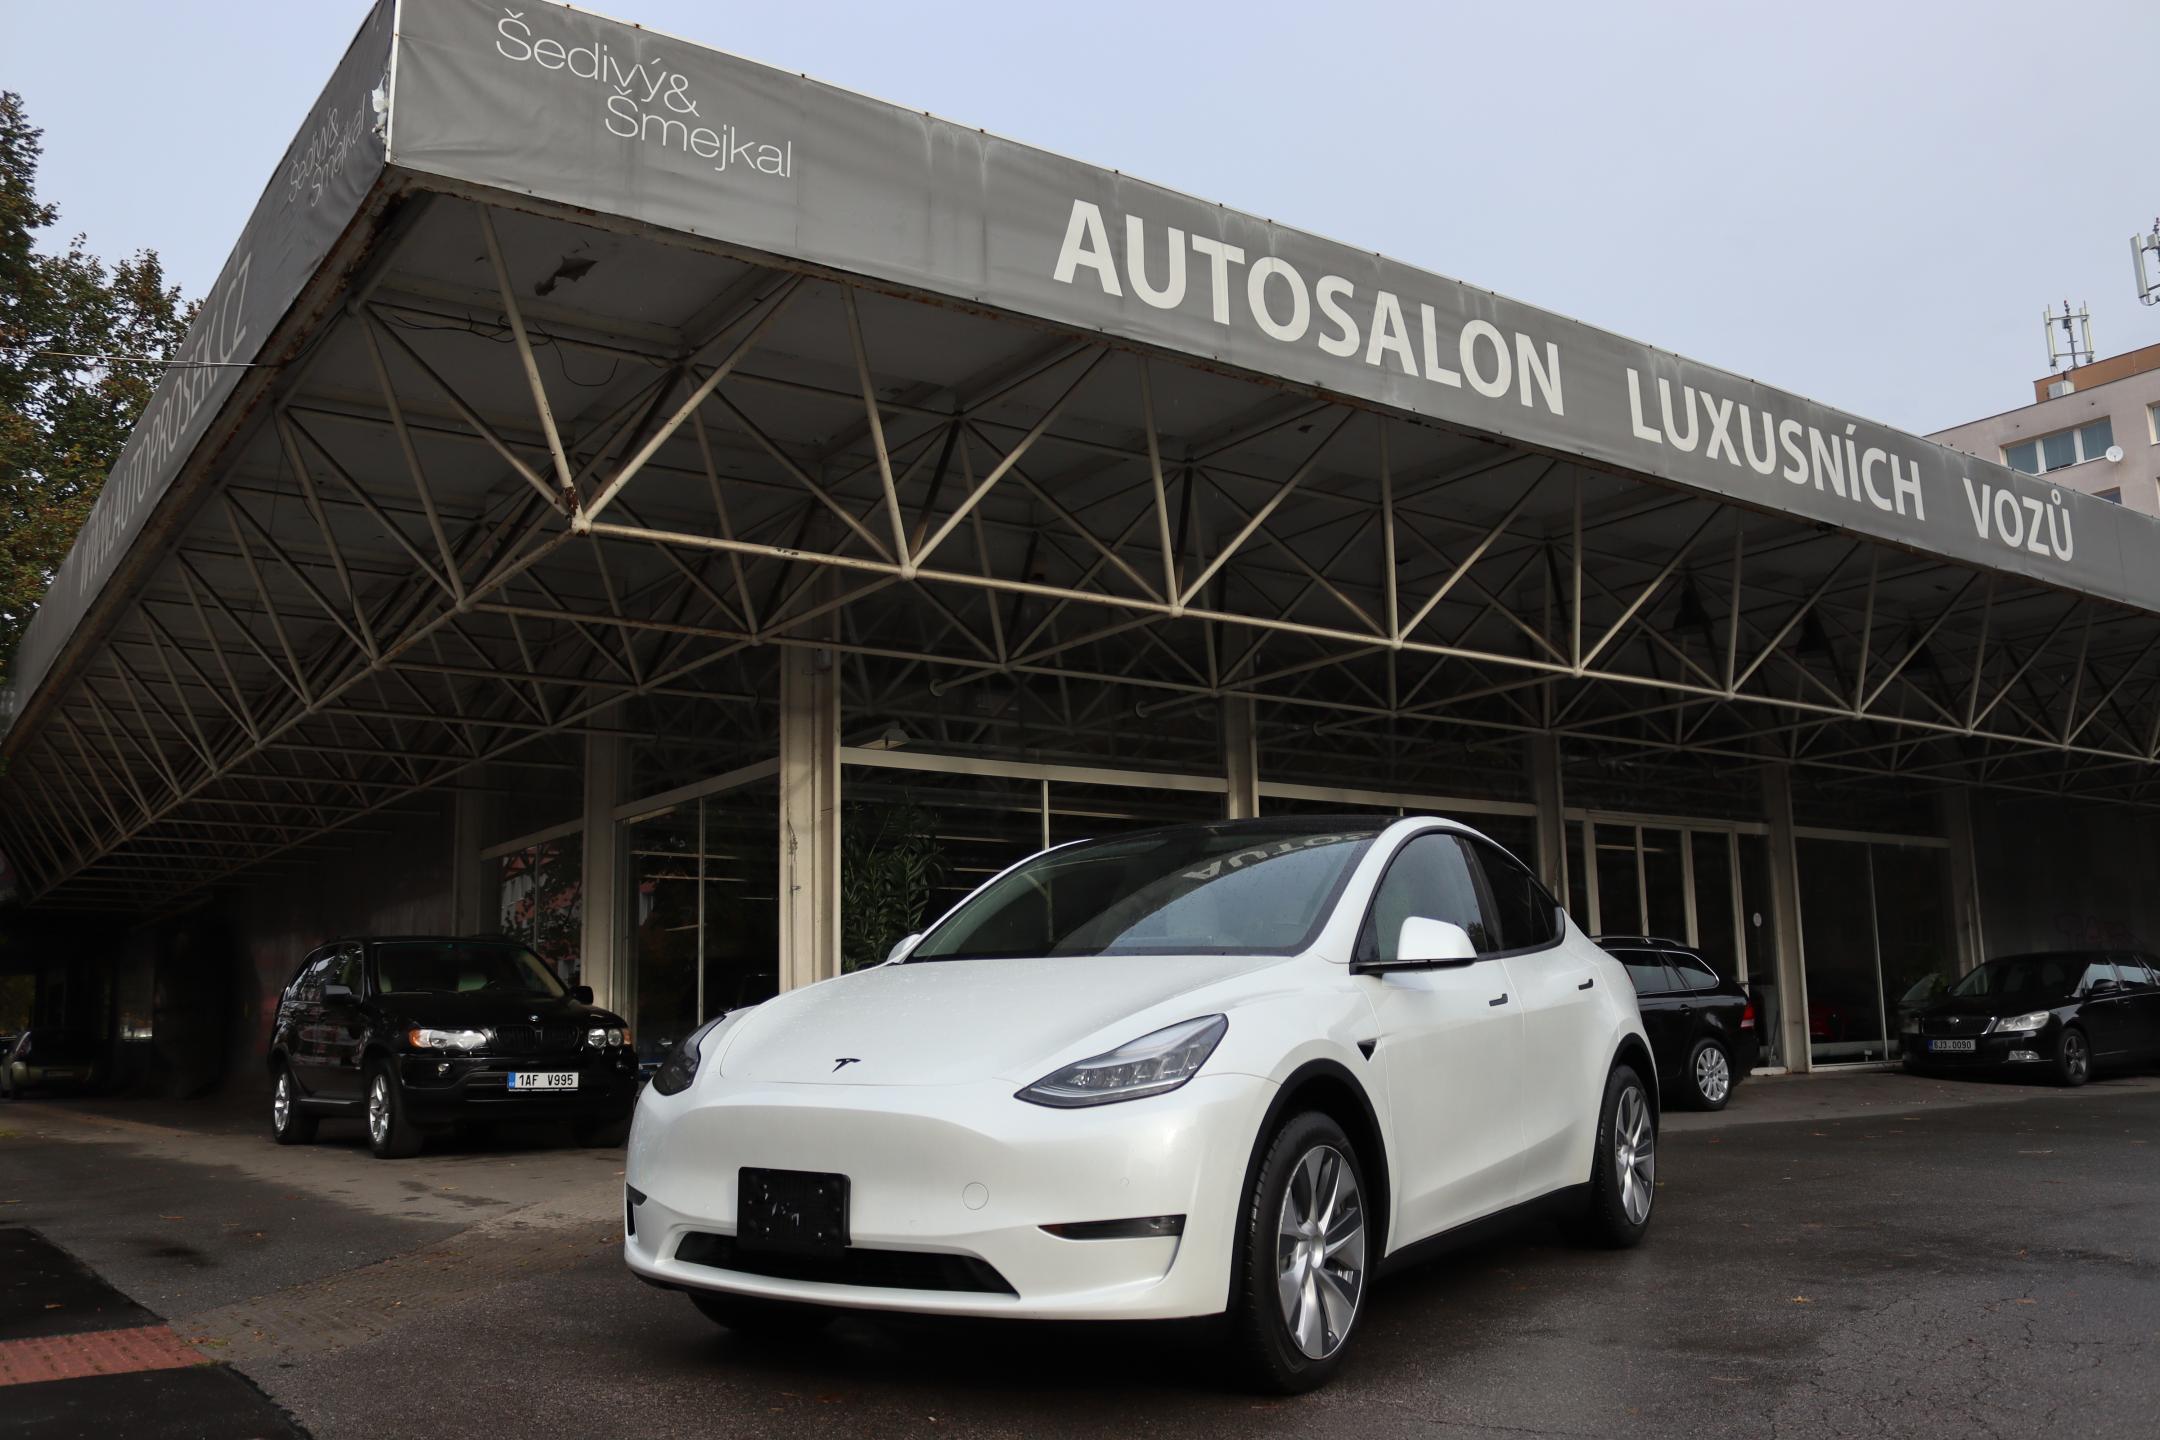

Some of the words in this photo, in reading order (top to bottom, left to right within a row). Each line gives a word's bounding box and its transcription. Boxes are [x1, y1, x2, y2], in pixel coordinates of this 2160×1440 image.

[495, 7, 701, 117] Šedivý&
[605, 85, 792, 178] Šmejkal
[1052, 198, 1565, 417] AUTOSALON
[1626, 367, 1926, 521] LUXUSNÍCH
[1962, 477, 2075, 562] VOZŮ
[519, 1074, 539, 1086] 1AF
[547, 1074, 574, 1086] V995
